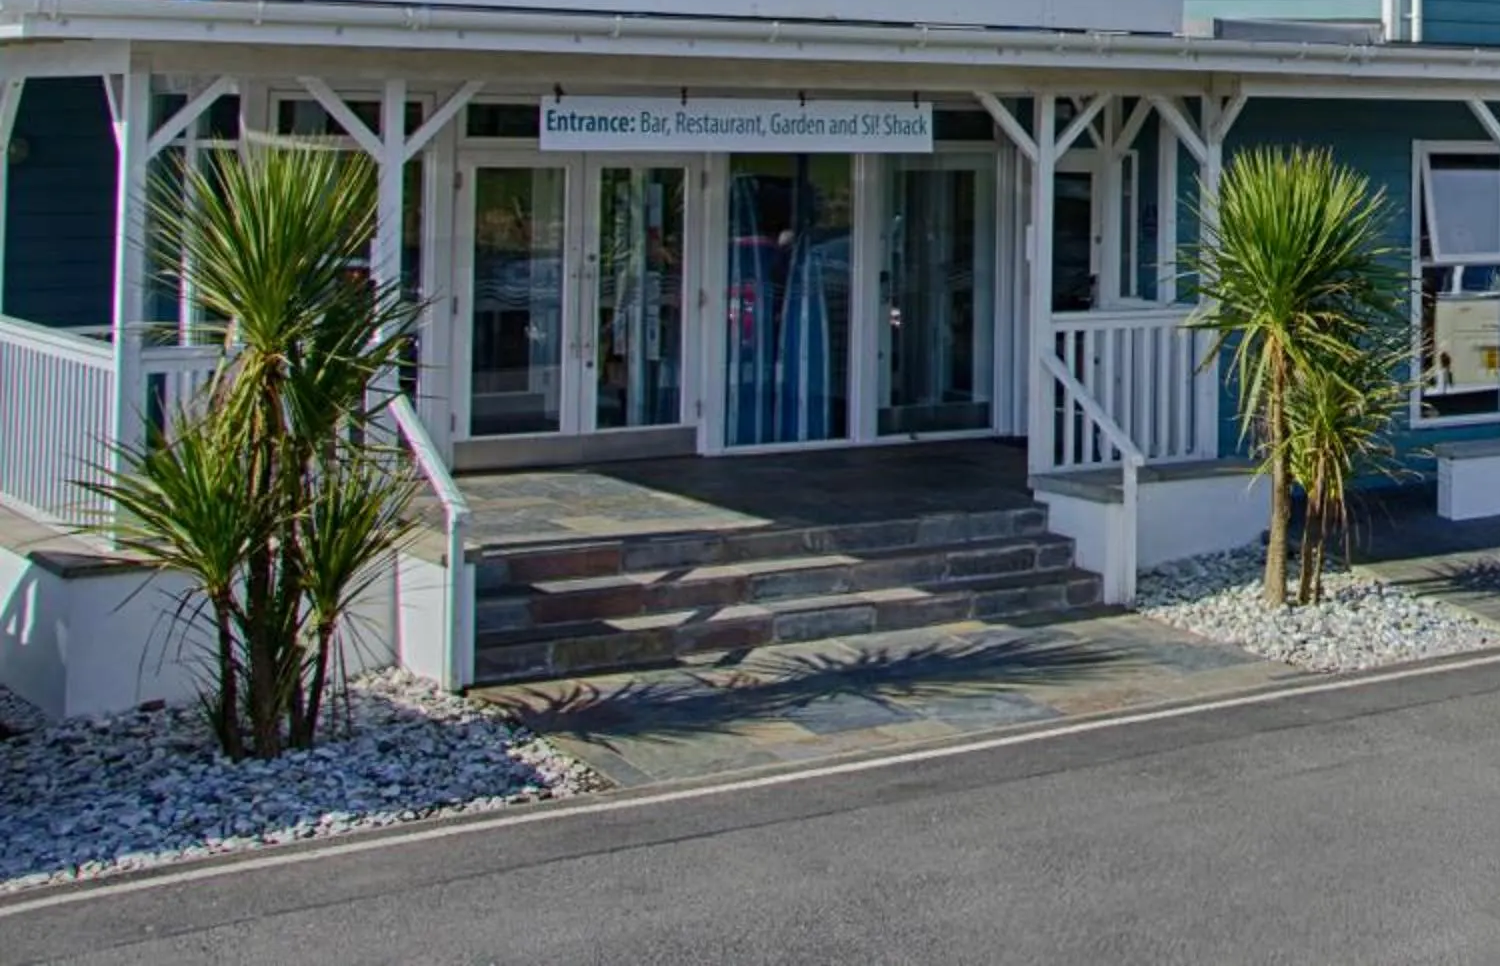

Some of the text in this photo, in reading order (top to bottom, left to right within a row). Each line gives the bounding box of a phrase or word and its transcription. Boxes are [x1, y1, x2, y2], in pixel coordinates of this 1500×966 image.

[546, 109, 636, 133] Entrance:
[641, 111, 671, 136] Bar,
[676, 112, 767, 137] Restaurant,
[770, 113, 826, 135] Garden
[829, 115, 858, 135] and
[884, 114, 927, 136] Shack
